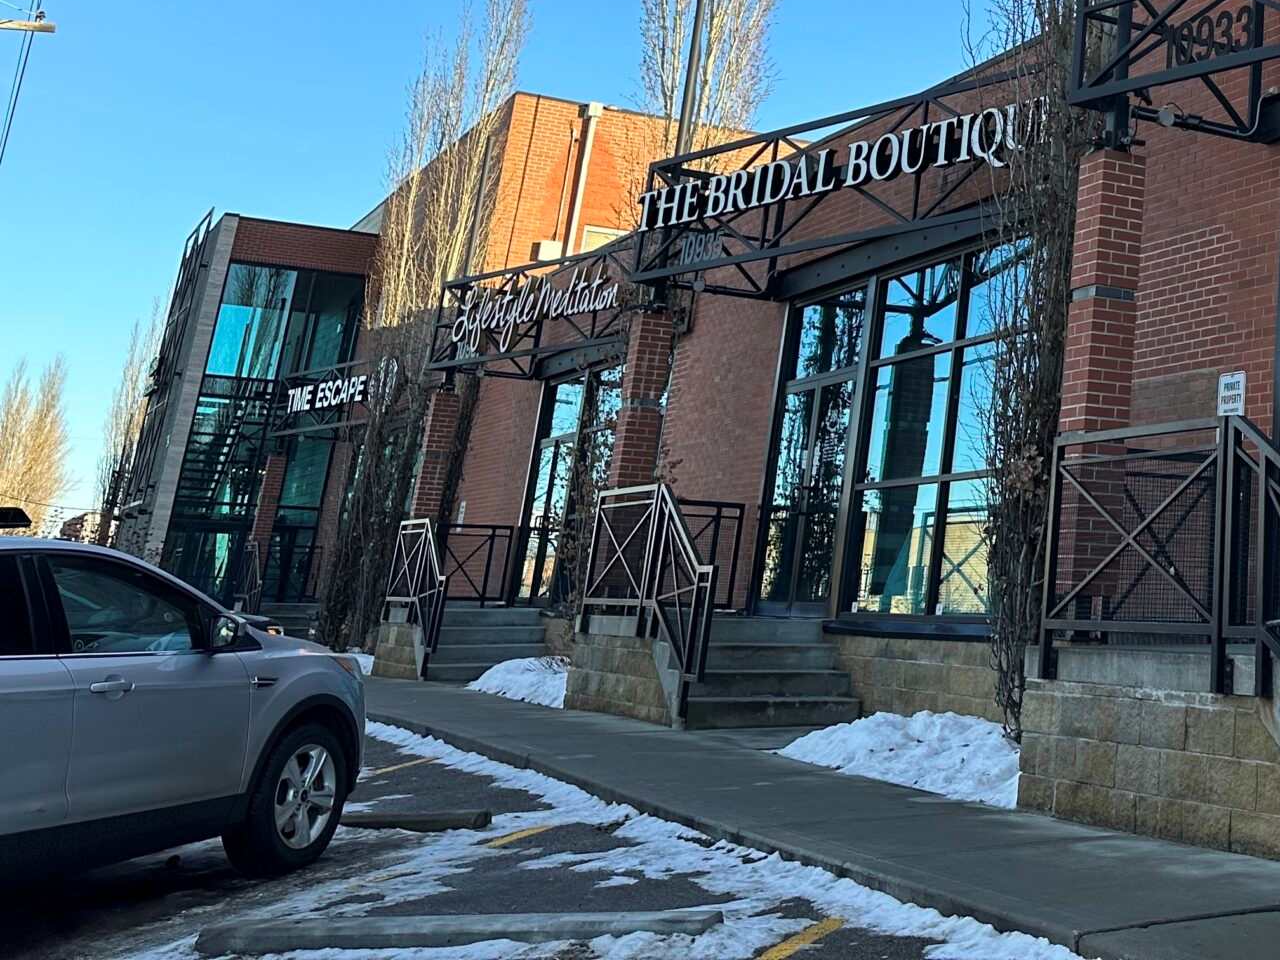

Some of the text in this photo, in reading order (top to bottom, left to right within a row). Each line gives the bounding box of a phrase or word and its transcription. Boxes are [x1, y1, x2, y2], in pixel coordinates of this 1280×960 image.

[1166, 5, 1255, 69] 10933
[638, 181, 700, 232] THE
[703, 149, 838, 218] BRIDAL
[452, 264, 618, 353] Lifestyle Meditation
[287, 385, 314, 414] TIME
[315, 375, 367, 409] ESCAPE
